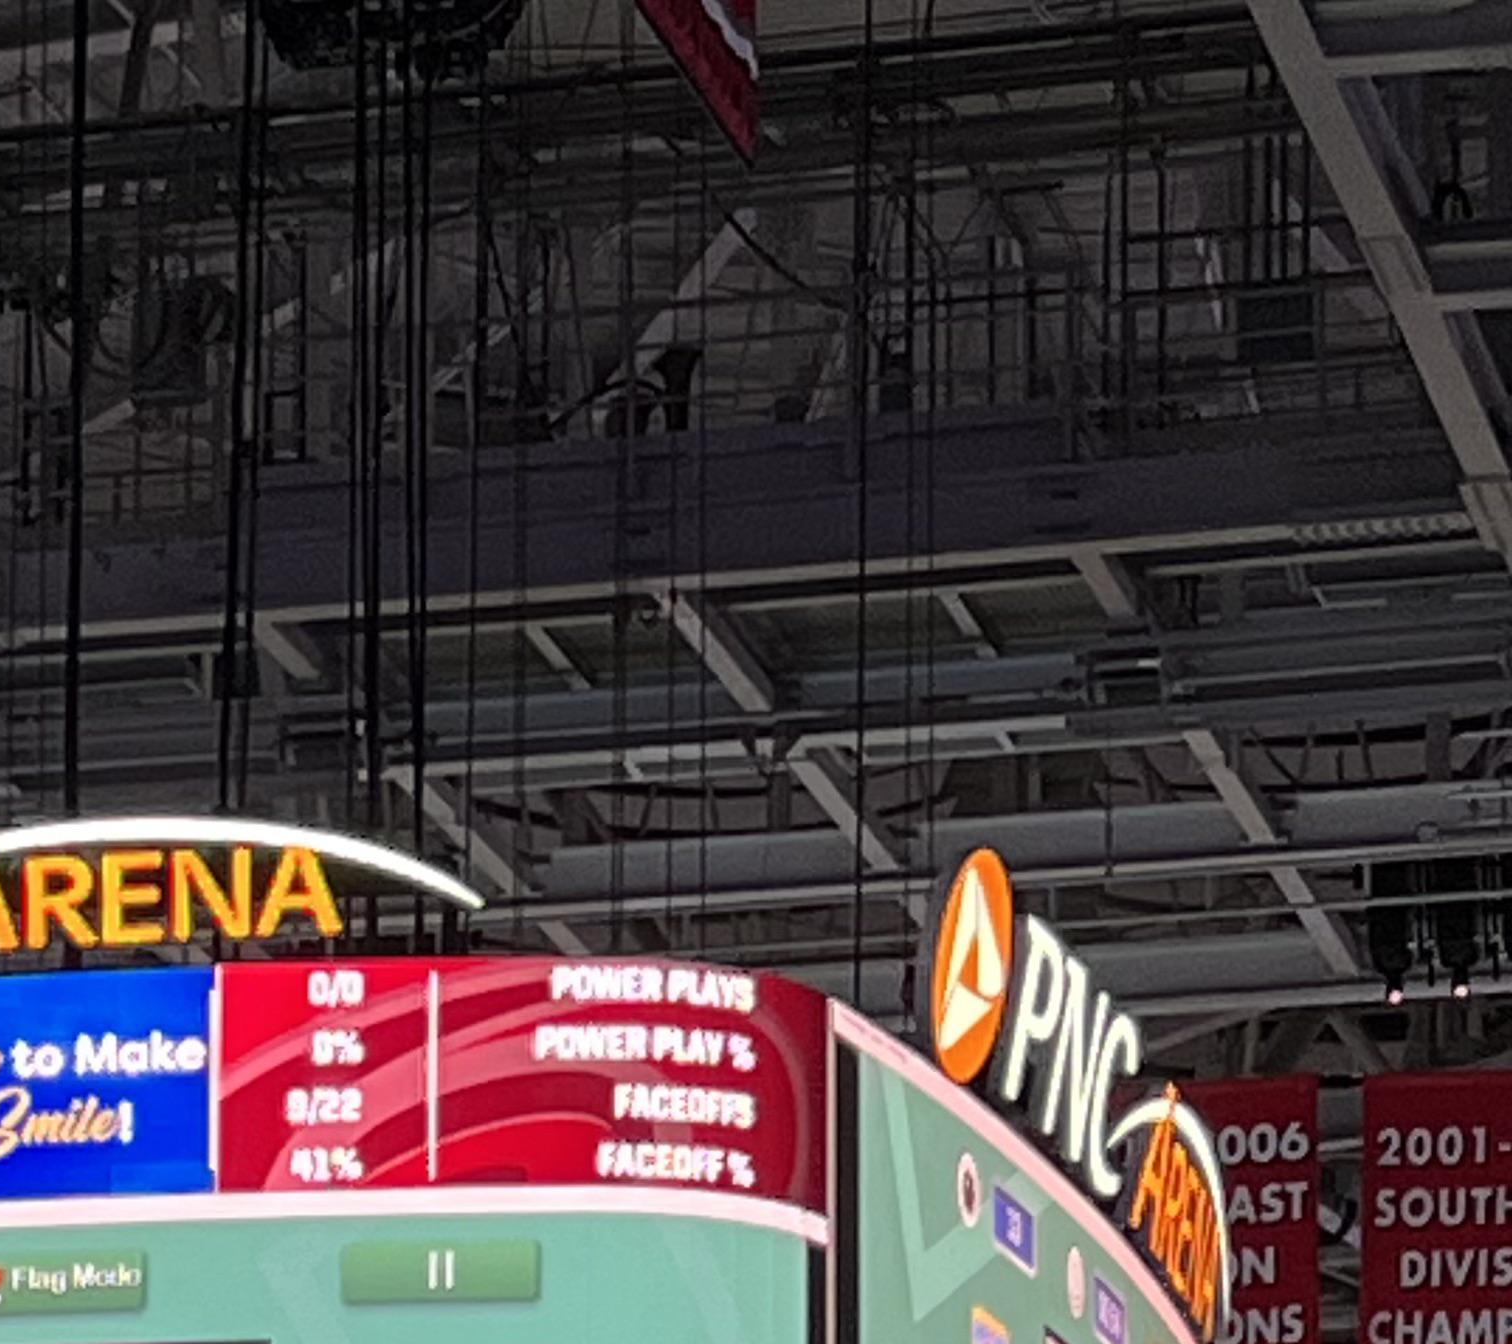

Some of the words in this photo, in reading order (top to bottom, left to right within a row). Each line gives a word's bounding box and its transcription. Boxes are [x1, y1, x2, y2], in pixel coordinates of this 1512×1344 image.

[550, 964, 662, 1002] POWER
[667, 969, 755, 1013] PLAYS
[10, 1040, 62, 1081] to
[73, 1031, 207, 1077] Make
[535, 1024, 648, 1061] POWER
[651, 1027, 726, 1066] PLAY
[1002, 914, 1142, 1196] PNC
[613, 1085, 756, 1129] FACEOFFS
[595, 1143, 725, 1182] FACEOFF
[1217, 1122, 1309, 1165] 006
[12, 1266, 65, 1294] Flag
